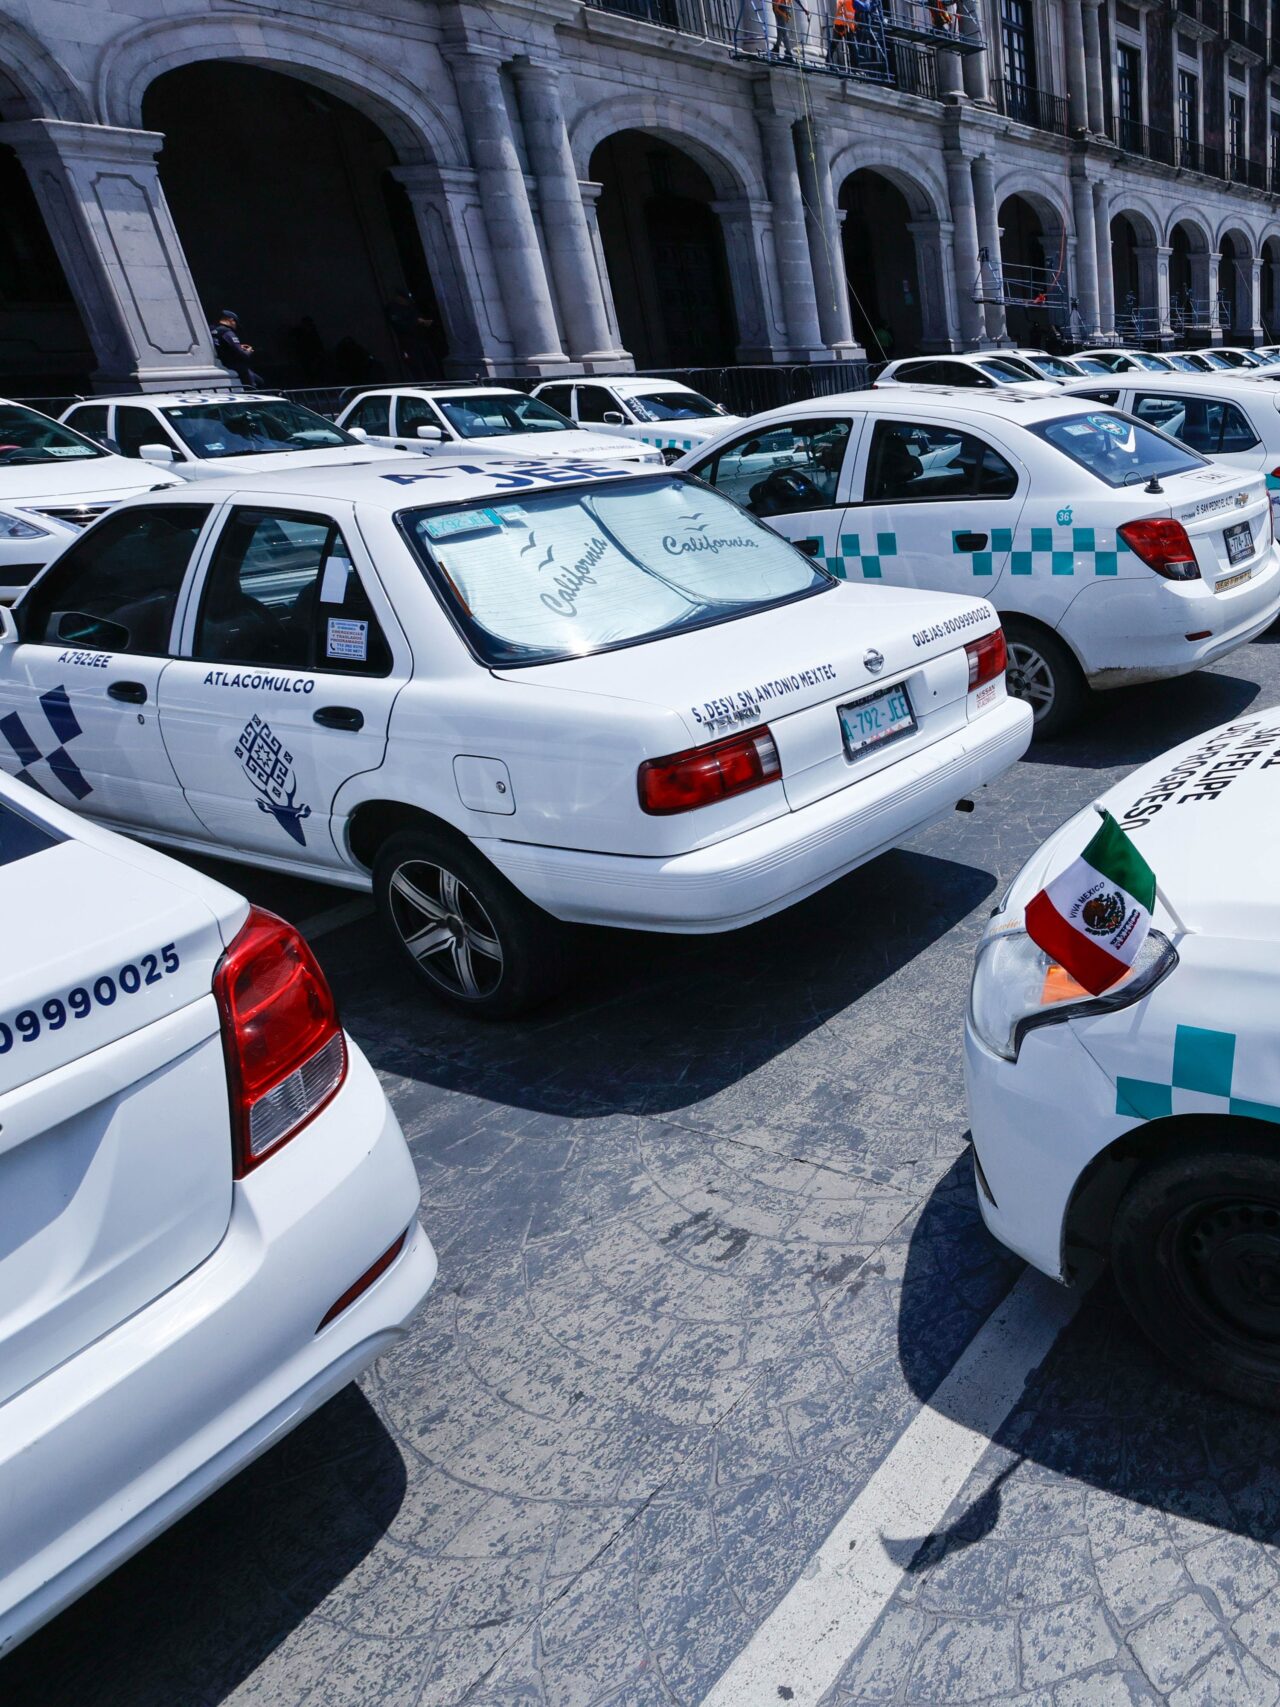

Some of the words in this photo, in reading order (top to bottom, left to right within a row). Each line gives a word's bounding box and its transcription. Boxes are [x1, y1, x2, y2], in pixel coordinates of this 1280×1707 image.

[487, 464, 633, 488] JEE
[1058, 511, 1070, 522] 36
[662, 535, 758, 555] California
[540, 536, 608, 618] California
[912, 605, 991, 648] QUEJAS:8009990025
[203, 670, 315, 694] ATLACOMULCO
[703, 695, 739, 719] DESV.
[799, 663, 837, 689] MEXTEC
[1205, 721, 1262, 745] DEL
[1119, 743, 1230, 832] PROGRESO
[1176, 751, 1262, 804] FELIPE
[1069, 904, 1081, 919] VIVA
[1079, 881, 1105, 904] MEXICO
